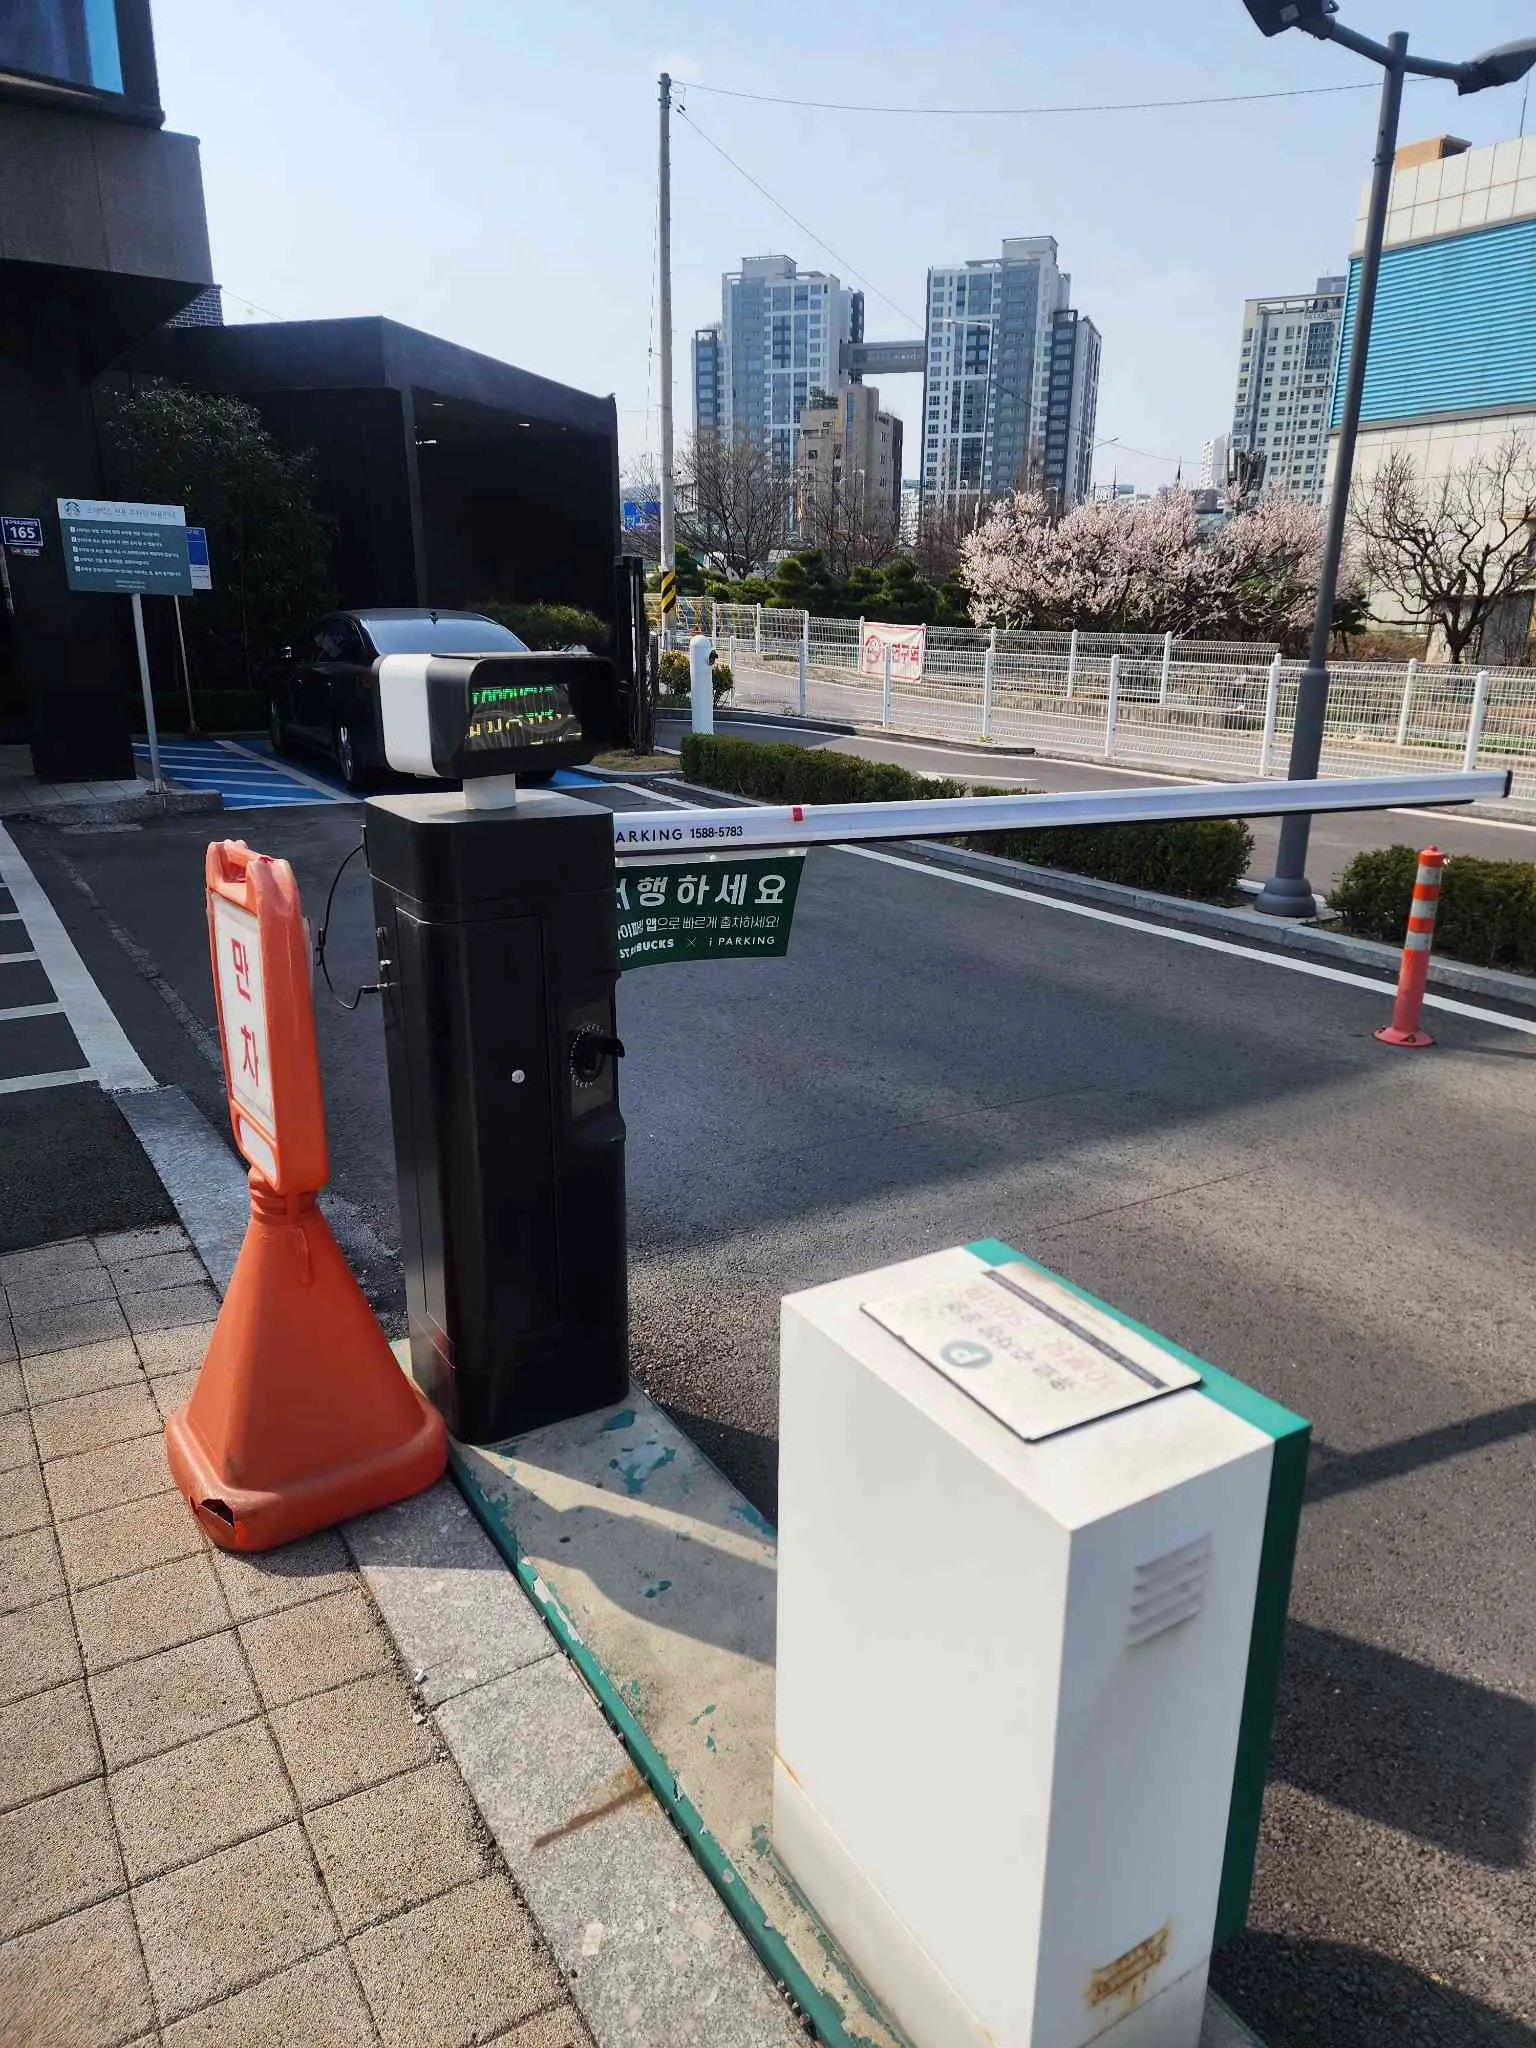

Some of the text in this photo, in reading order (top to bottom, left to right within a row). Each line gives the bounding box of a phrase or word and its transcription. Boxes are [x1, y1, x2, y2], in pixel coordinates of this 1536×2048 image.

[10, 526, 36, 539] 165
[690, 826, 743, 839] 1588-5783
[645, 916, 680, 932] 앱으로
[682, 915, 718, 930] 빠르게
[619, 938, 675, 959] STARBUCKS
[718, 936, 776, 946] PARKING
[231, 937, 260, 1089] 만차
